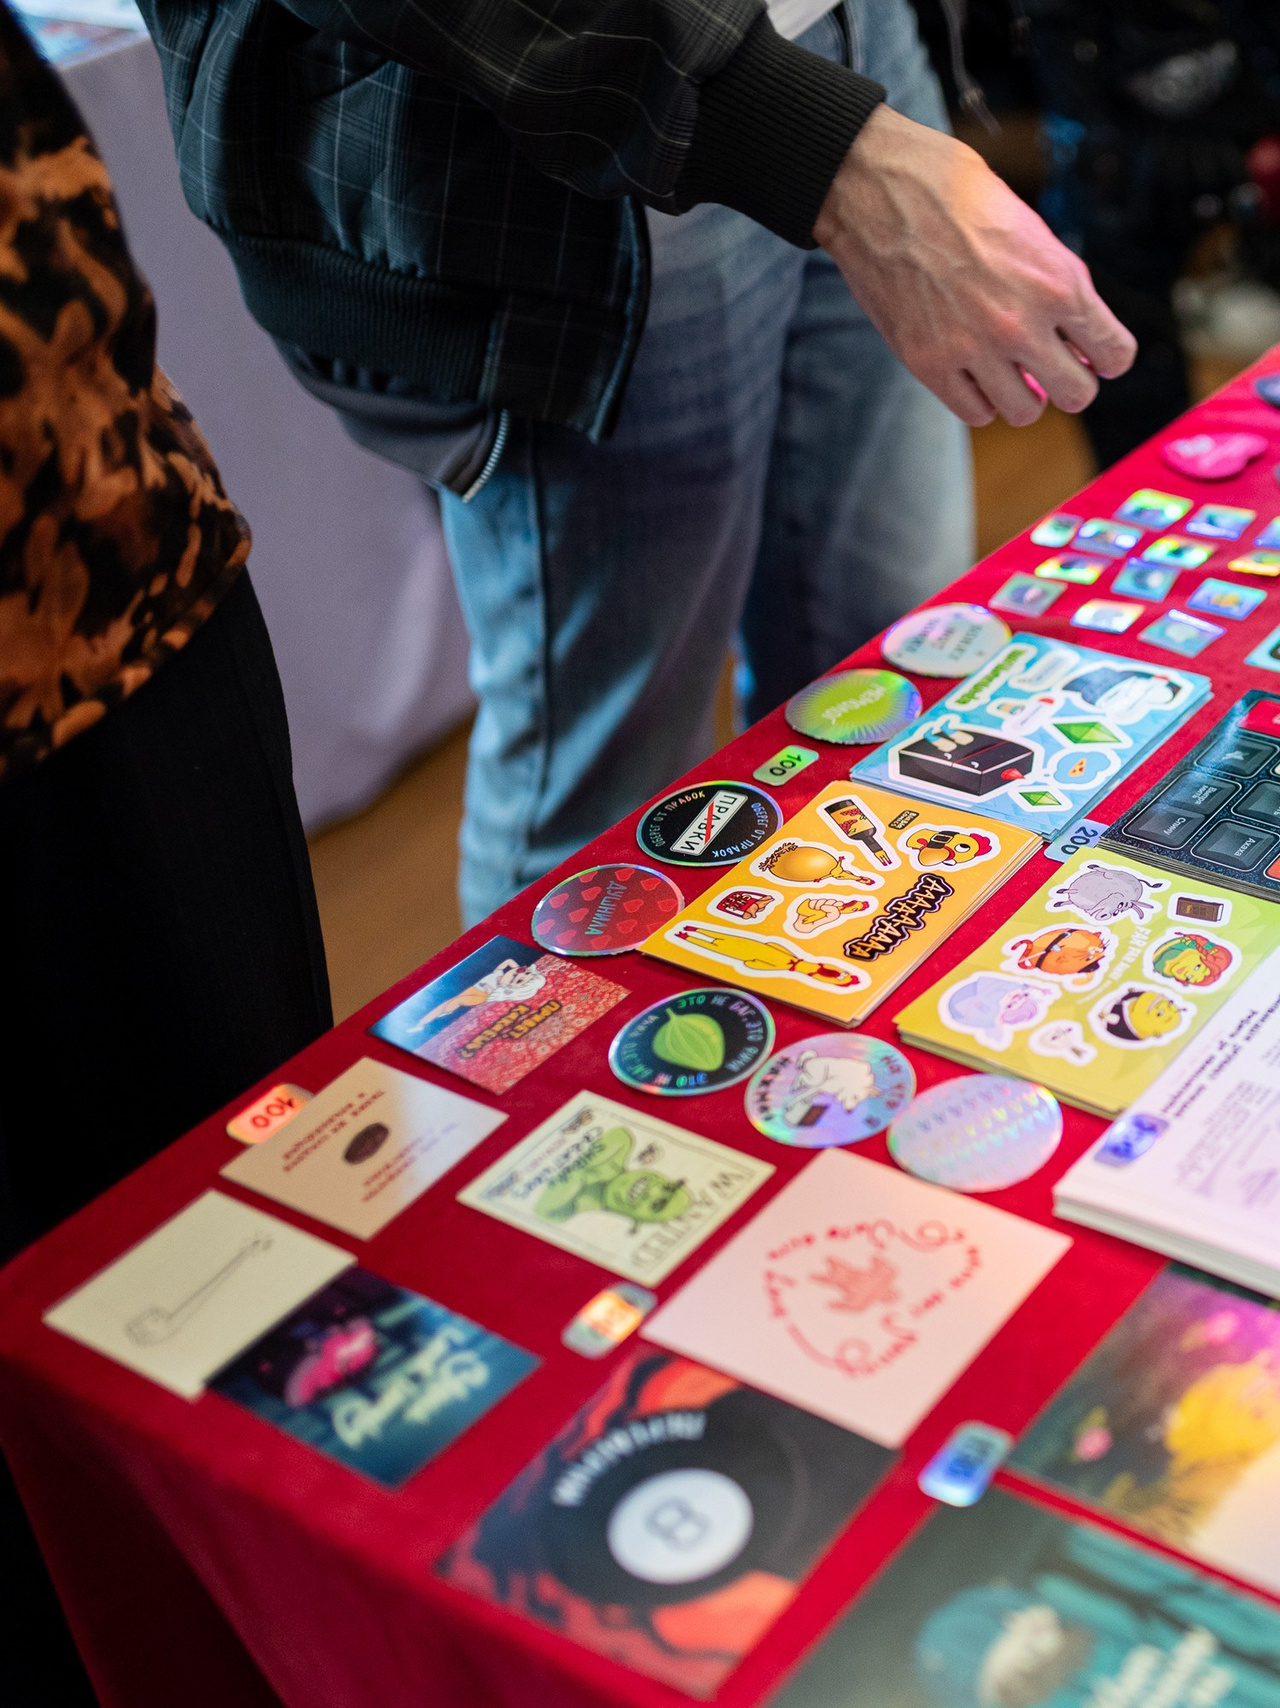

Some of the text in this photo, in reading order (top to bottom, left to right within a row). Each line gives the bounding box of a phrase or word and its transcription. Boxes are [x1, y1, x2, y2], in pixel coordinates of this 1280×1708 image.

[770, 755, 805, 777] 100
[1160, 816, 1187, 835] Спину
[711, 839, 755, 857] ПРАВОК
[1062, 827, 1099, 857] 200
[1232, 837, 1256, 857] Ахаха
[583, 879, 626, 938] ДУШНИЛА
[677, 993, 708, 1010] ЭТО
[501, 999, 563, 1042] ПРИВЕТ,
[251, 1096, 295, 1129] 100
